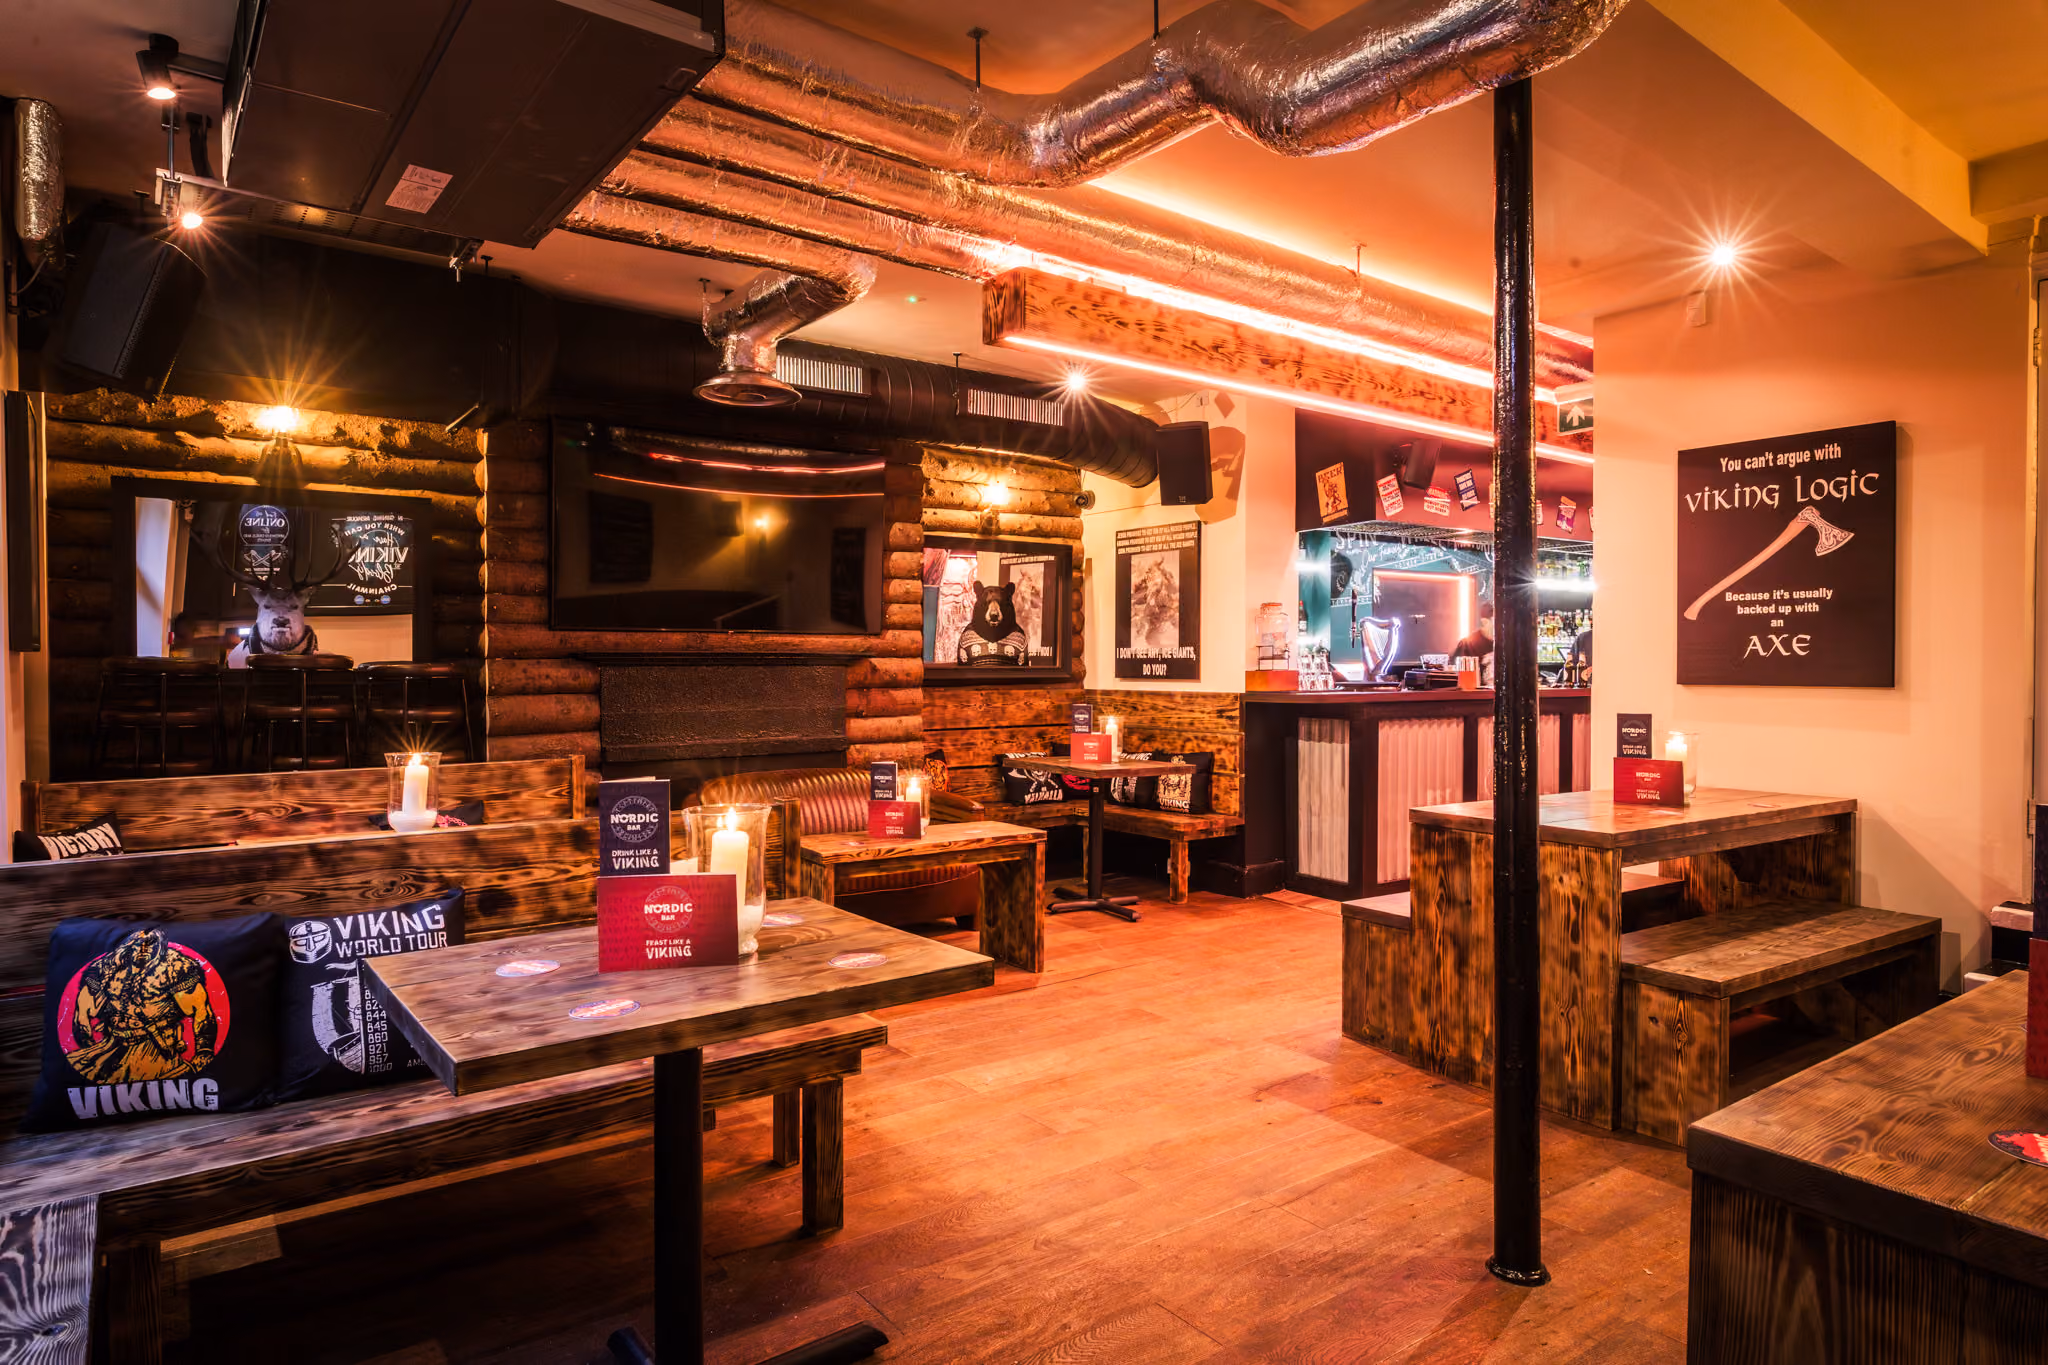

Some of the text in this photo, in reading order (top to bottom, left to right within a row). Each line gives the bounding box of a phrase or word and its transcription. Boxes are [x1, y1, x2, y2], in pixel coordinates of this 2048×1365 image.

[1720, 443, 1842, 473] You can't argue with
[1794, 469, 1879, 503] LOGIC
[1725, 587, 1833, 602] Because it's usually
[1736, 602, 1819, 615] backed up with
[1770, 618, 1784, 627] an
[1743, 633, 1811, 659] AXE
[1142, 663, 1167, 676] DO YOU?
[1160, 798, 1190, 809] VIKING
[610, 813, 659, 824] NORDIC
[37, 823, 121, 861] VICTORY
[611, 849, 635, 857] DRINK
[635, 848, 652, 856] LIKE
[612, 856, 660, 870] VIKING
[644, 902, 693, 914] NORDIC
[333, 904, 445, 939] VIKING
[335, 931, 448, 958] WORLD TOUR
[646, 945, 692, 960] VIKING
[368, 1031, 388, 1043] 860
[368, 1043, 387, 1055] 921
[369, 1054, 388, 1065] 957
[67, 1077, 219, 1119] VIKING
